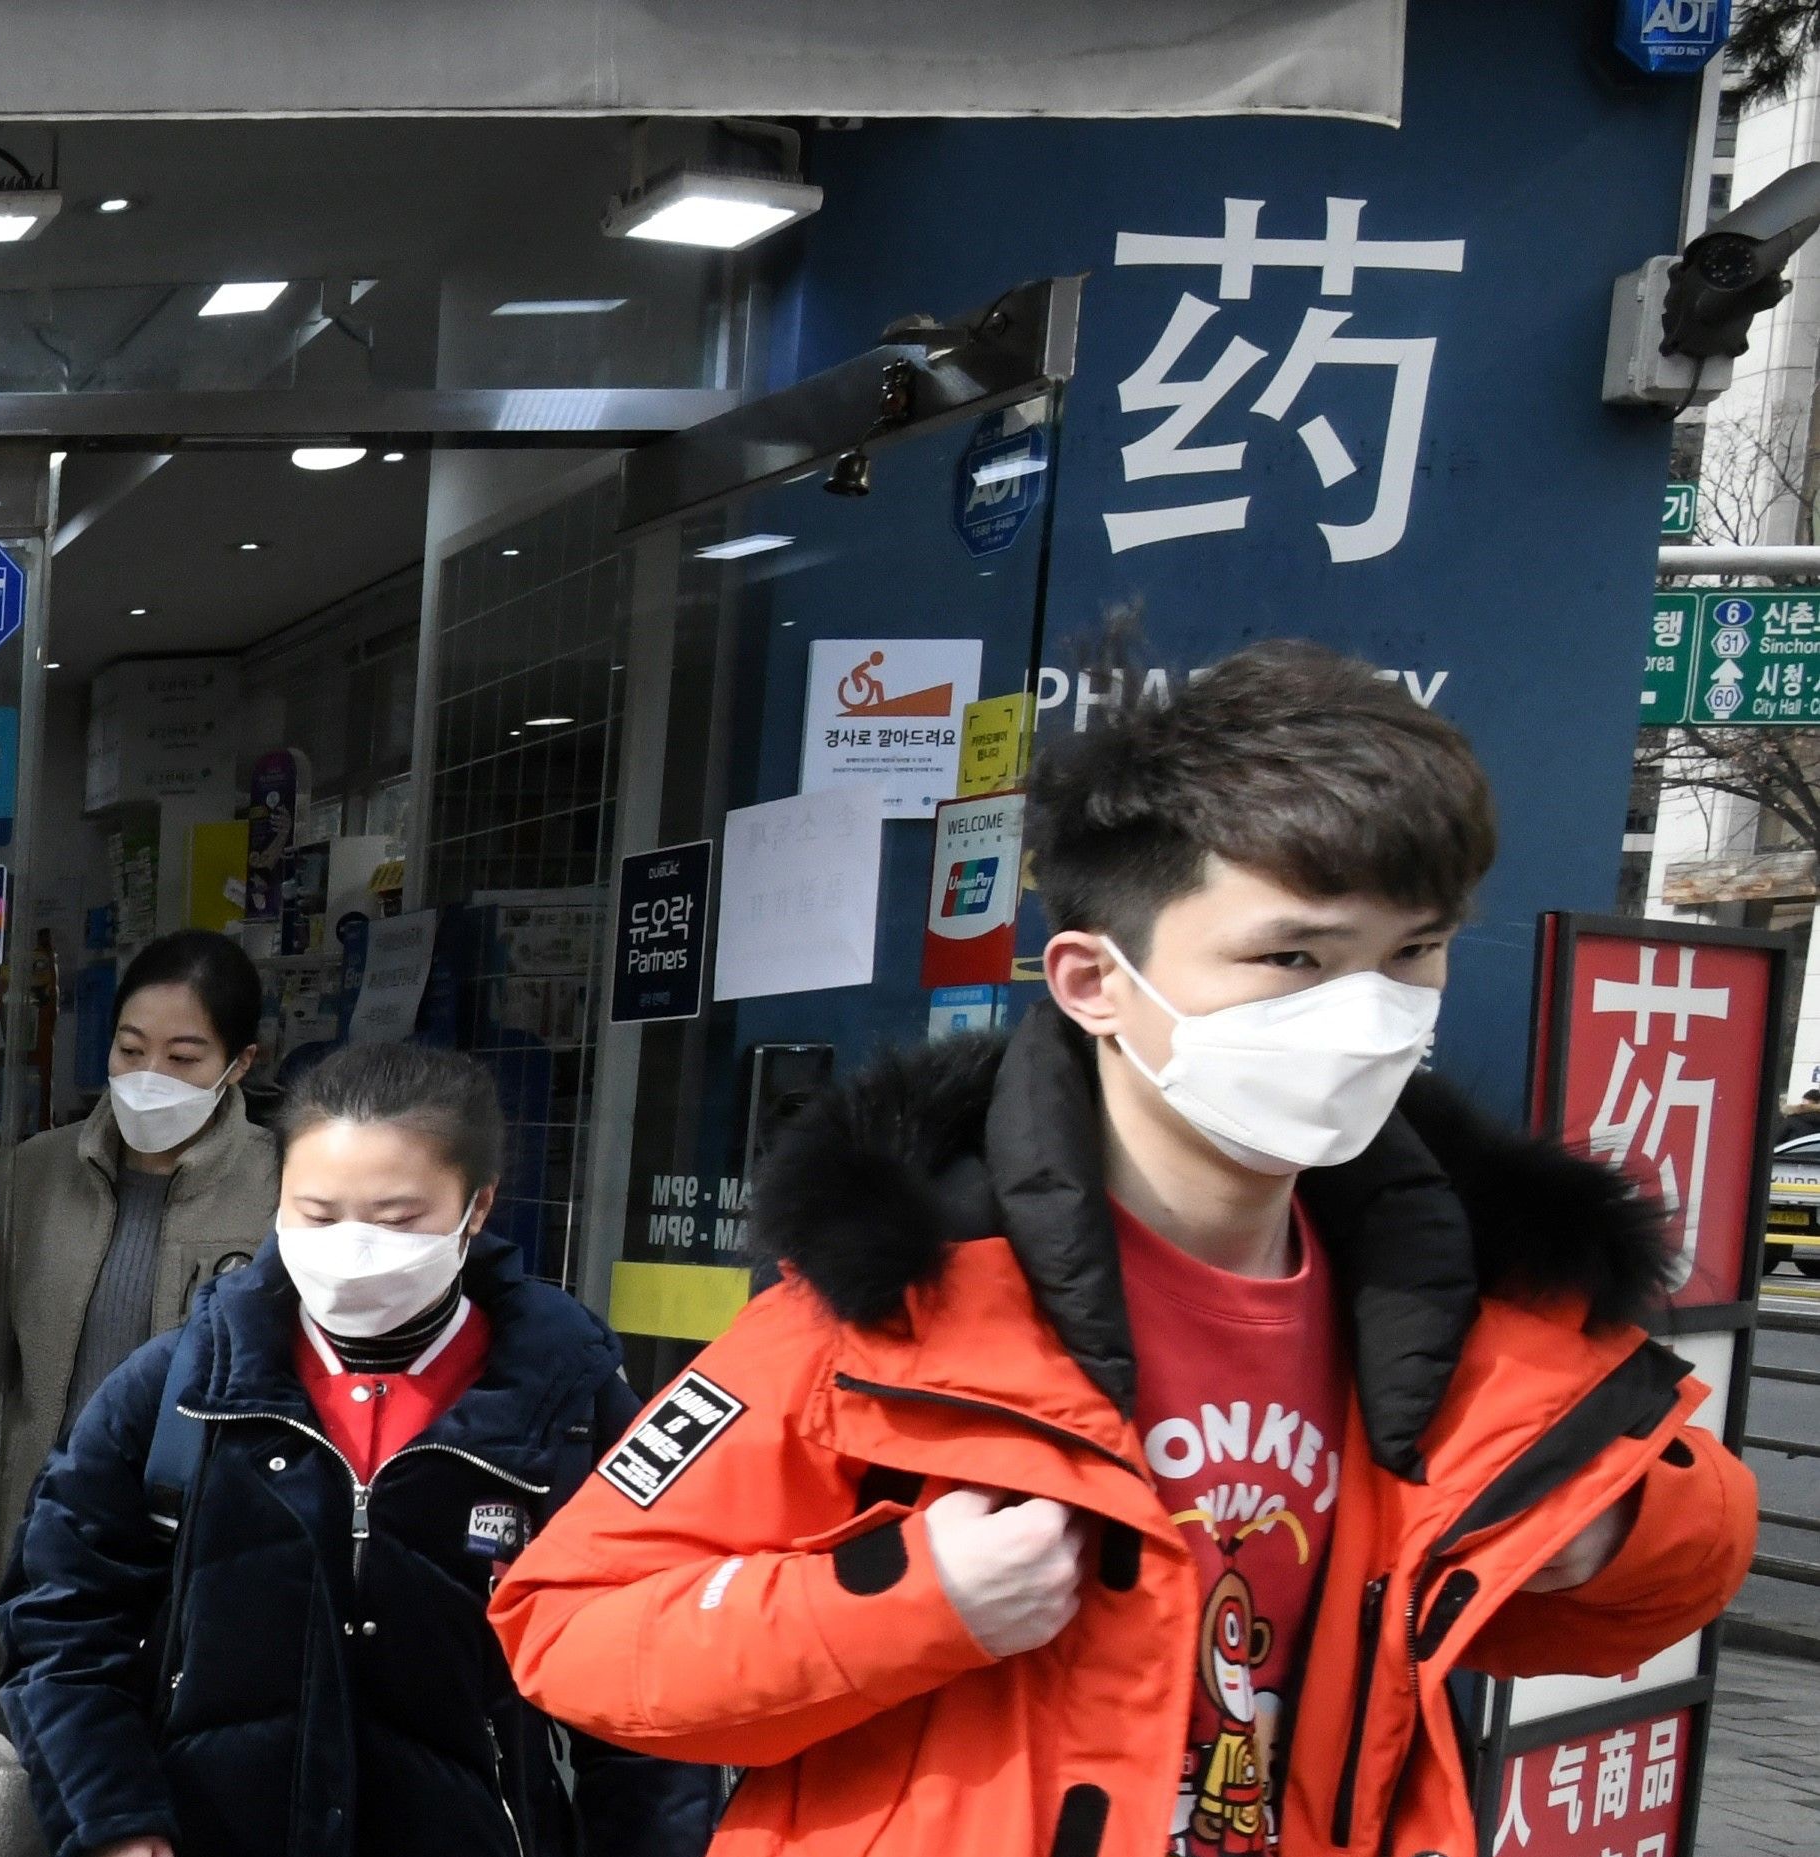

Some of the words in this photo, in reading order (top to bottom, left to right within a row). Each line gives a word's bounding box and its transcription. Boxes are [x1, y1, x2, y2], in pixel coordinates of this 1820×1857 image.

[1642, 0, 1716, 33] ADT
[1648, 46, 1685, 56] WORLD
[1103, 197, 1465, 564] 药
[1726, 603, 1740, 624] 6
[1762, 601, 1820, 635] 신촌
[1653, 610, 1684, 648] 행
[1722, 634, 1740, 651] 31
[1714, 690, 1734, 708] 60
[1752, 698, 1777, 716] City
[1779, 698, 1802, 716] Hall
[824, 729, 872, 748] 경사로
[877, 729, 957, 748] 깔아드려요
[947, 811, 1005, 836] WELCOME
[628, 893, 694, 945] 듀오락
[627, 946, 688, 975] Partners
[1588, 945, 1730, 1294] 药
[474, 1519, 500, 1535] VFA
